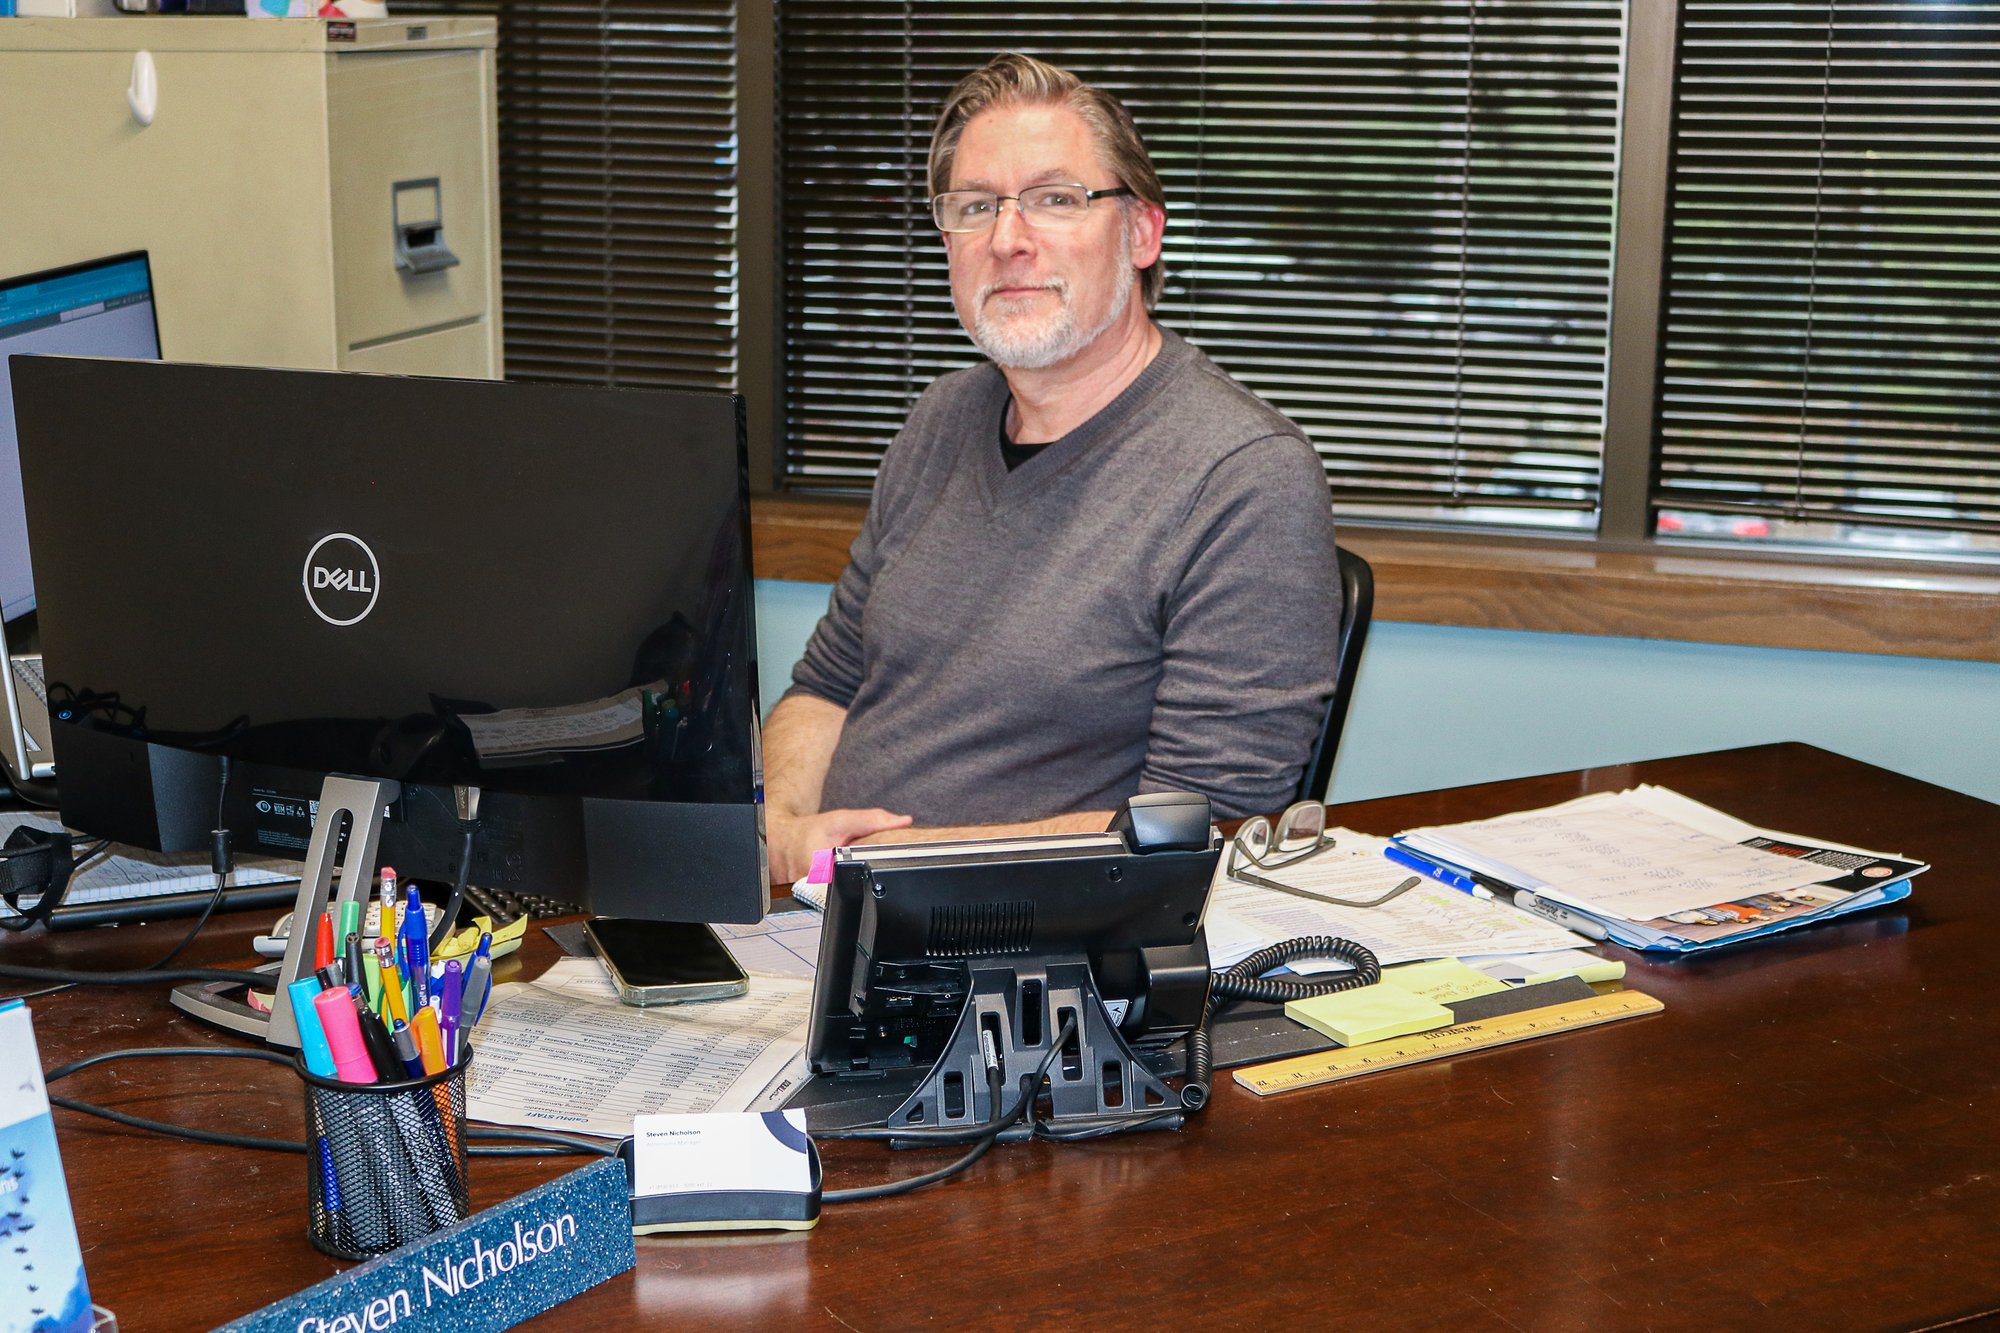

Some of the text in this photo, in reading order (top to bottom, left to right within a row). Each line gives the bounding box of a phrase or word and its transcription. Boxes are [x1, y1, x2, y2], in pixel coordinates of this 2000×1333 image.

[313, 566, 372, 593] DELL
[524, 1112, 554, 1120] STAFF
[421, 1213, 576, 1307] Nicholson
